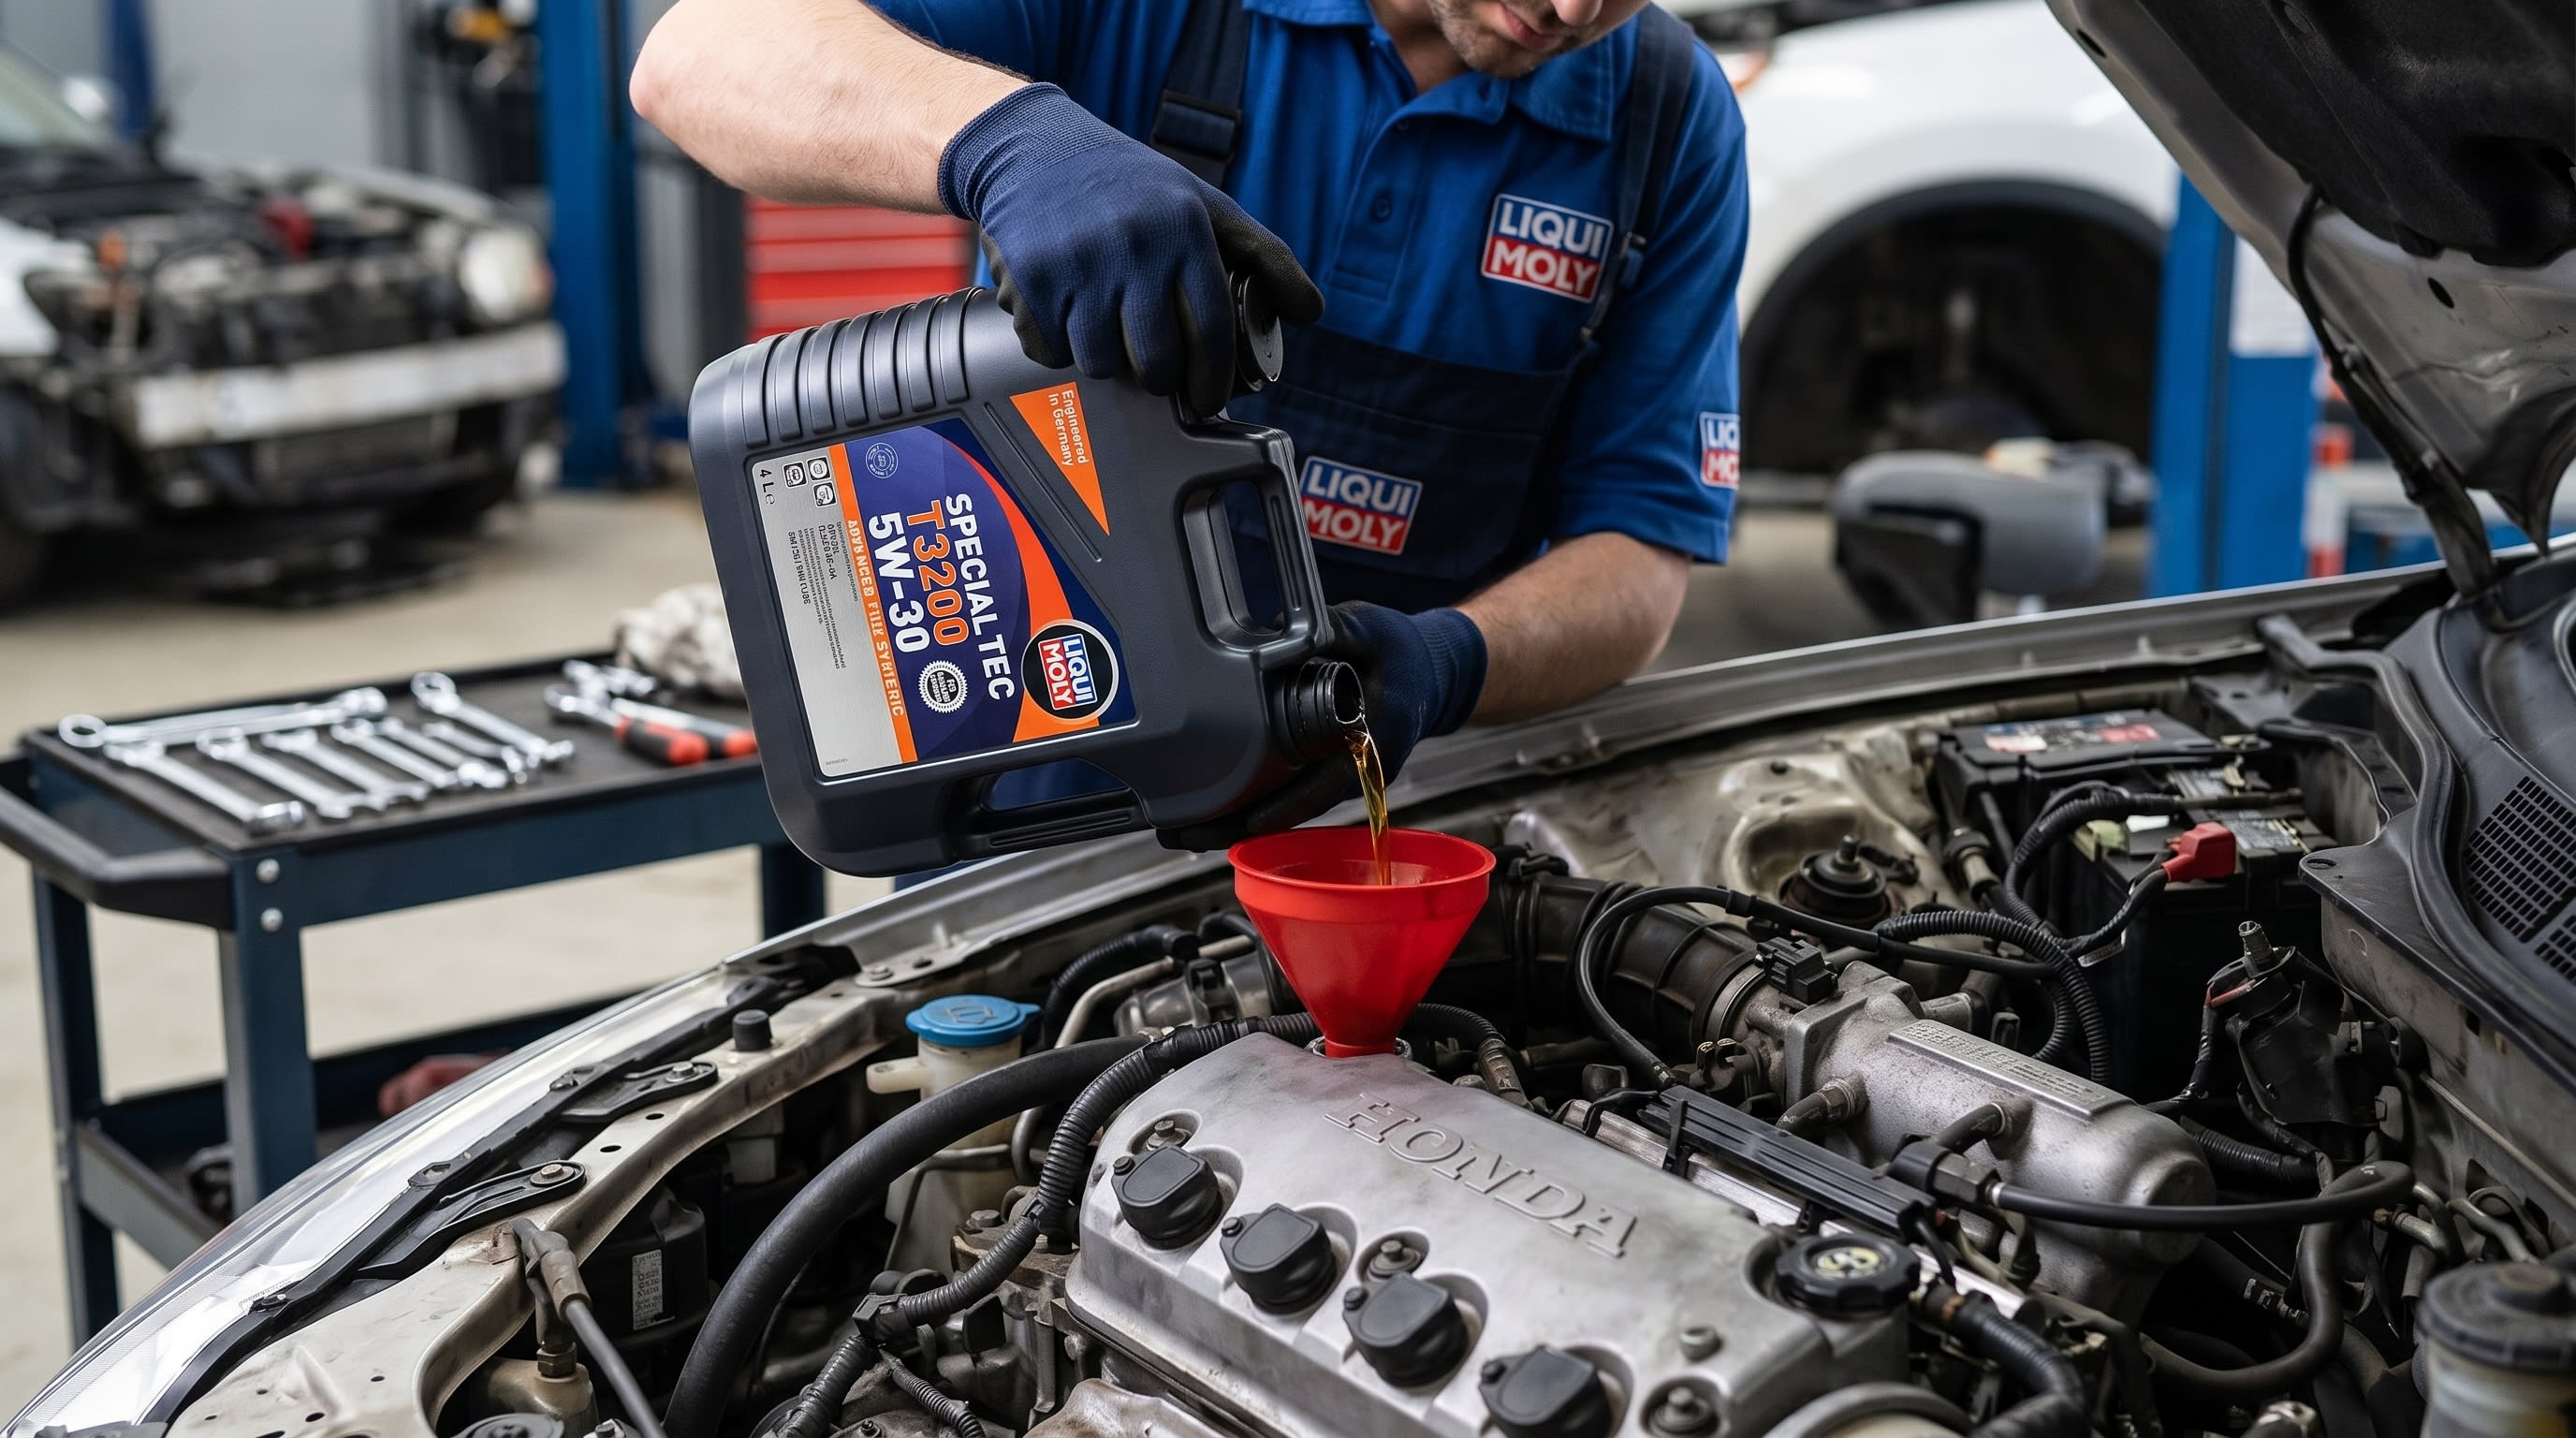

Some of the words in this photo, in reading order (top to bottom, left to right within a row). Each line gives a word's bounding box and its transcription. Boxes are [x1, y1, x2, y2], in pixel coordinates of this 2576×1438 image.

[1499, 201, 1605, 258] LIQUI
[1490, 240, 1597, 294] MOLY
[1052, 408, 1074, 466] Germany
[760, 469, 771, 477] 4
[1307, 464, 1412, 515] LIQUI
[1303, 499, 1404, 548] MOLY
[869, 512, 930, 653] 5W-30
[906, 499, 969, 646] T3200
[945, 493, 998, 636] SPECIAL
[978, 634, 1016, 700] TEC
[1043, 642, 1073, 704] MOLY
[1062, 638, 1093, 701] LIQUI
[1324, 1092, 1638, 1259] HONDA
